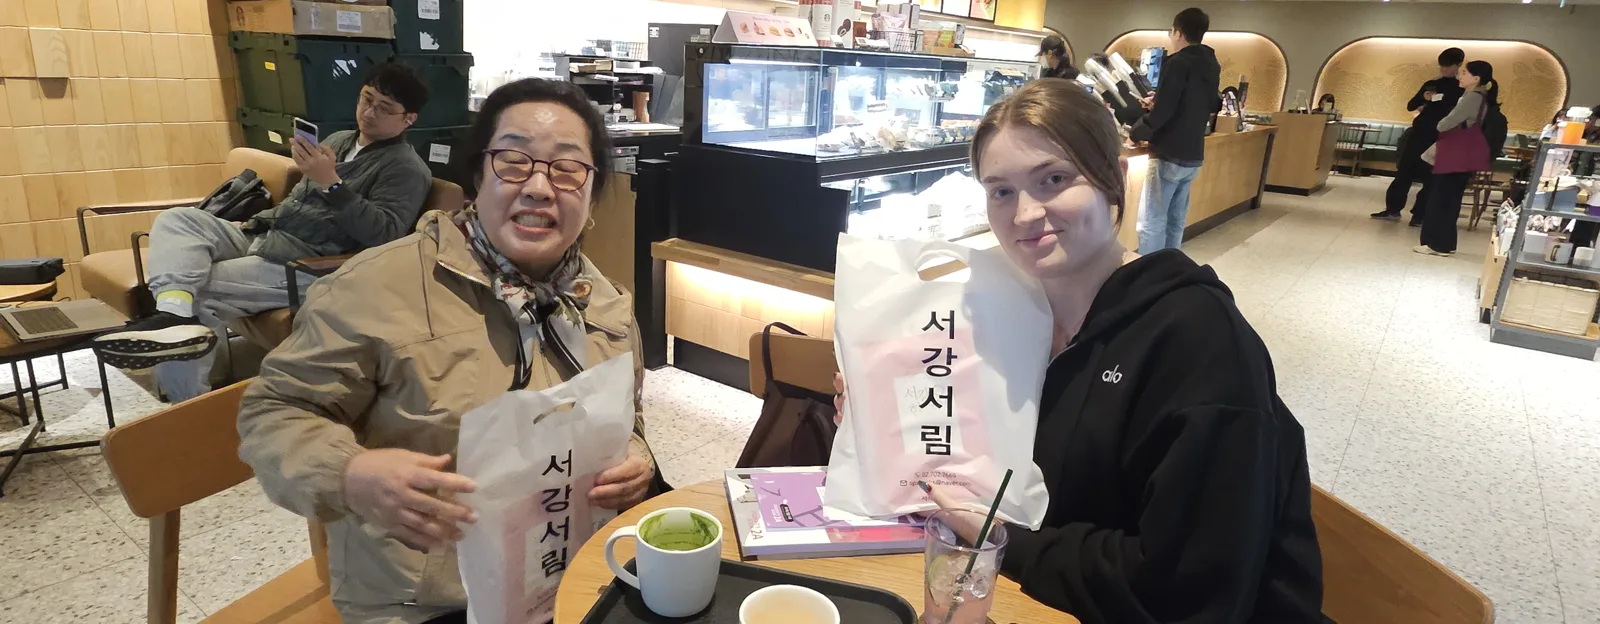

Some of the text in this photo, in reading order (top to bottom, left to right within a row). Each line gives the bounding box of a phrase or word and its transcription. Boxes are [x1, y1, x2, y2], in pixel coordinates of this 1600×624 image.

[919, 310, 958, 456] 서강서림
[1102, 364, 1123, 384] alo
[539, 449, 573, 578] 서강서림
